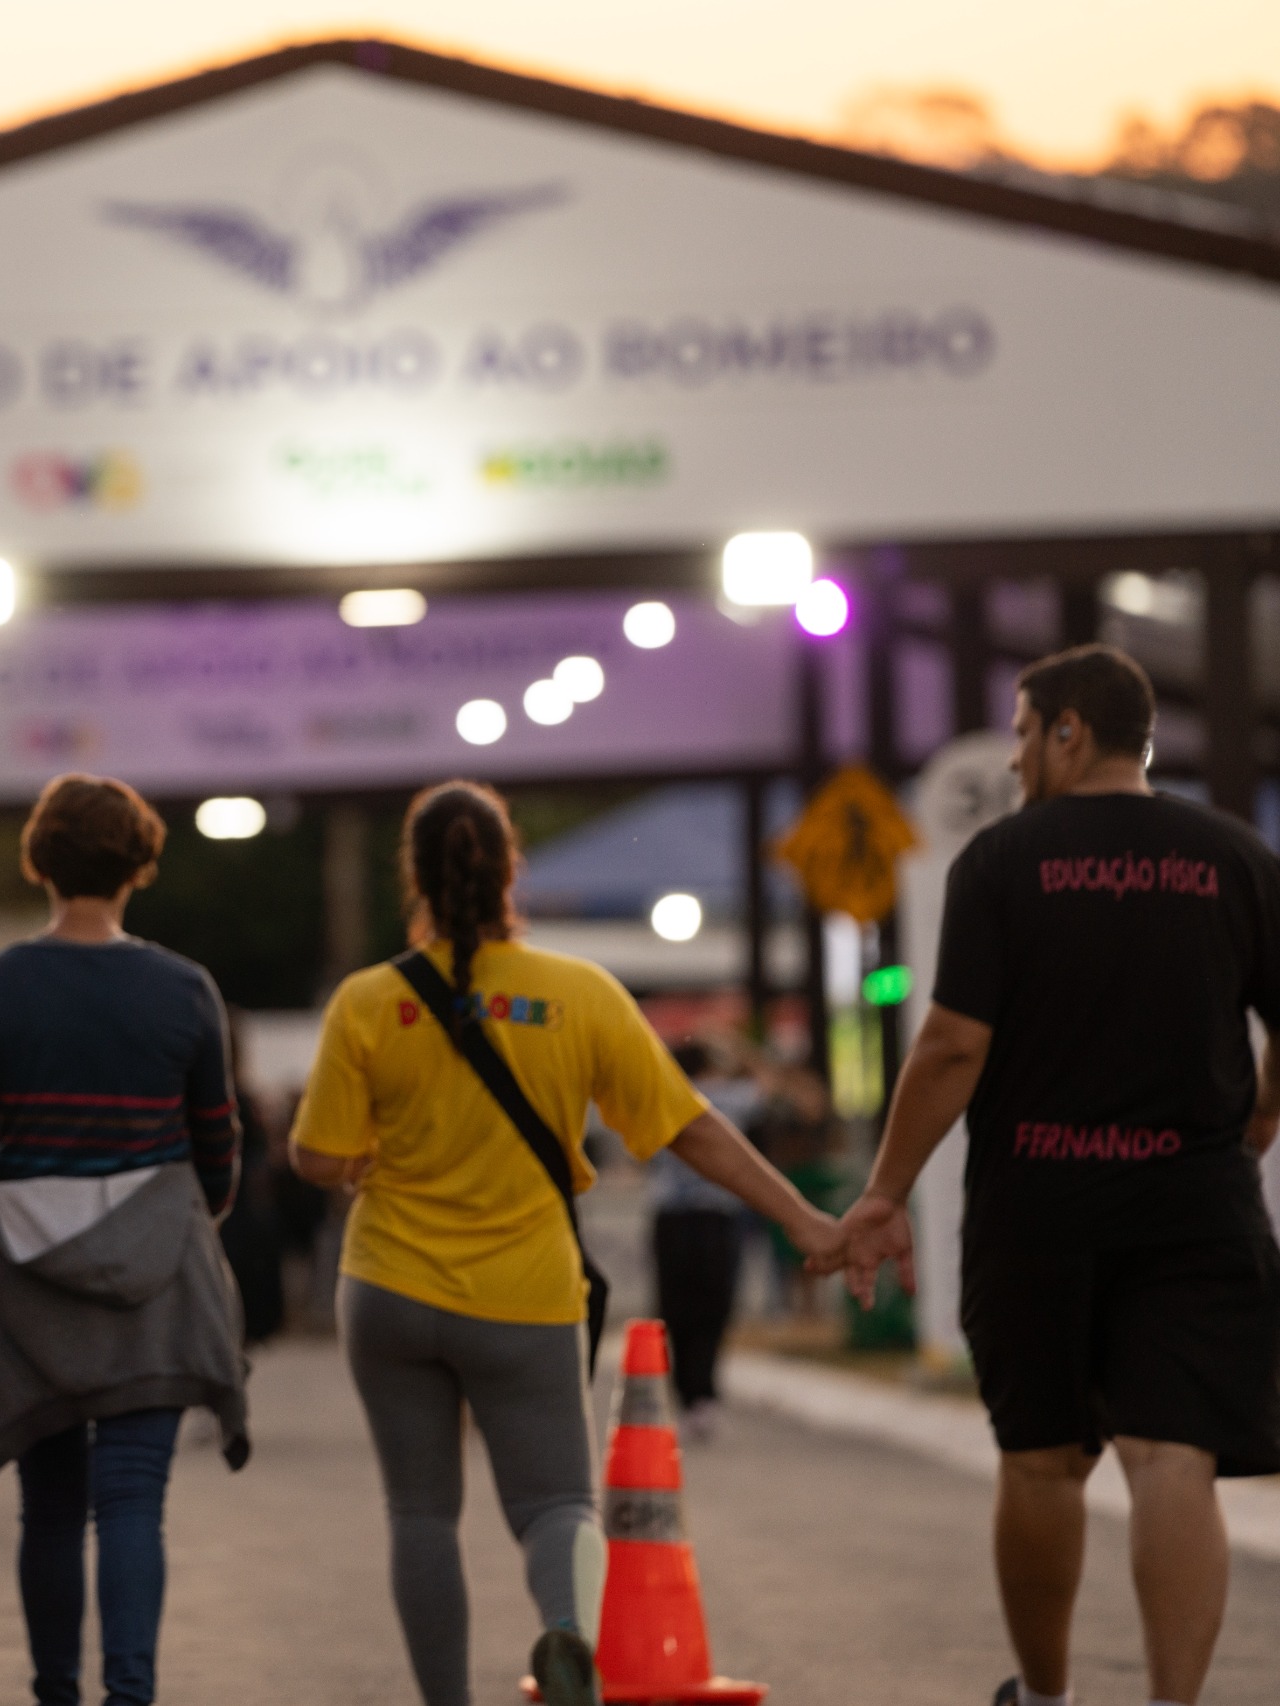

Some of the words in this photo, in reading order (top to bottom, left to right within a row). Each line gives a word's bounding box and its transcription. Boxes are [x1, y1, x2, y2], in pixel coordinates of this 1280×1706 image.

[37, 336, 148, 411] DE
[175, 324, 442, 402] APOIO
[461, 319, 588, 393] AO
[1039, 850, 1156, 900] EDUCAÇÃO
[1159, 850, 1219, 897] FÍSICA
